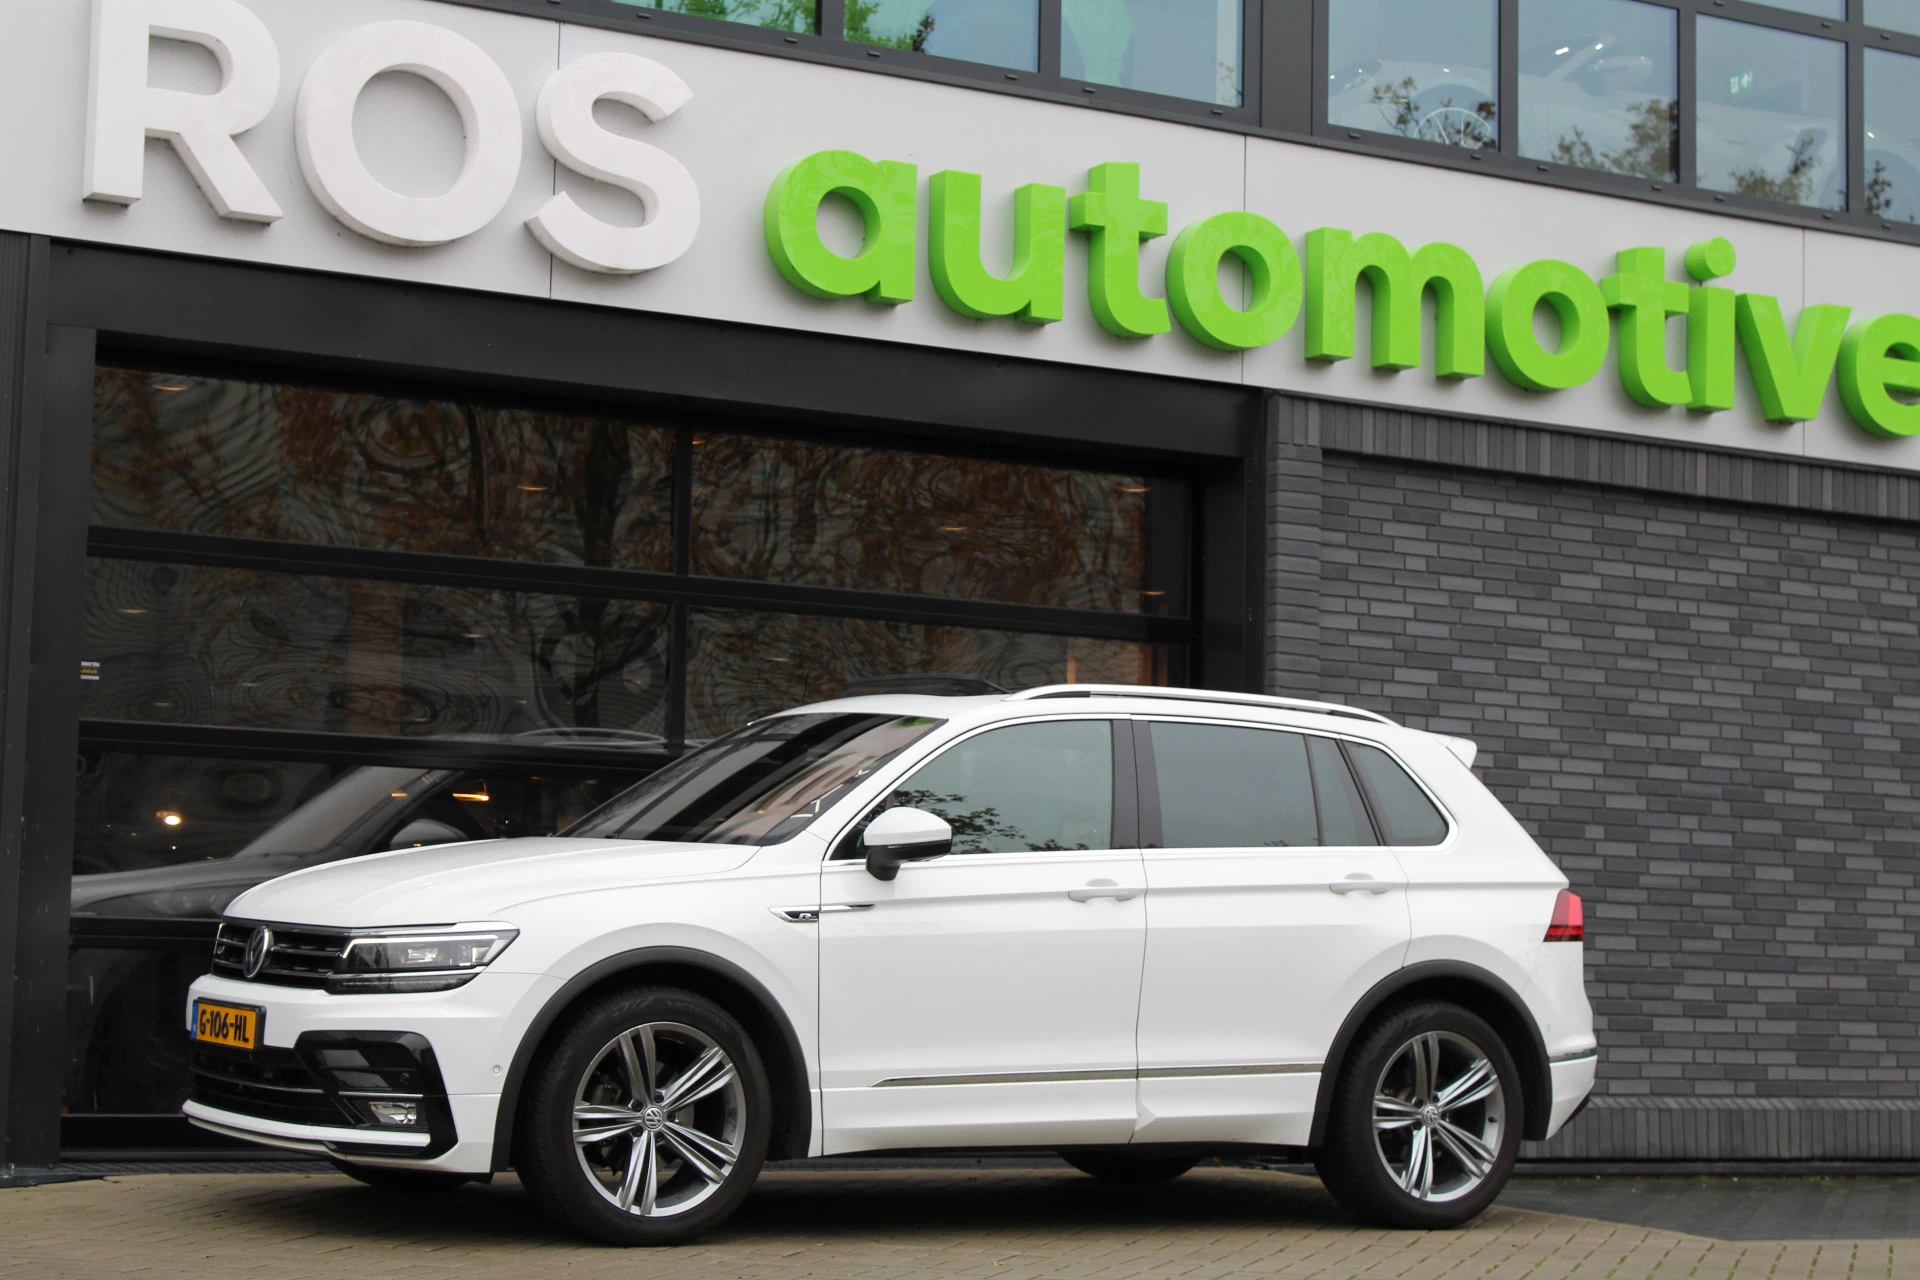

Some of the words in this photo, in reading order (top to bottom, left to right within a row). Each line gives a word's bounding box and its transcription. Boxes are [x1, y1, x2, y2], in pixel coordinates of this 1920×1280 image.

[83, 0, 701, 274] ROS
[764, 150, 1920, 438] automotive
[200, 1009, 249, 1043] G-106-HL
